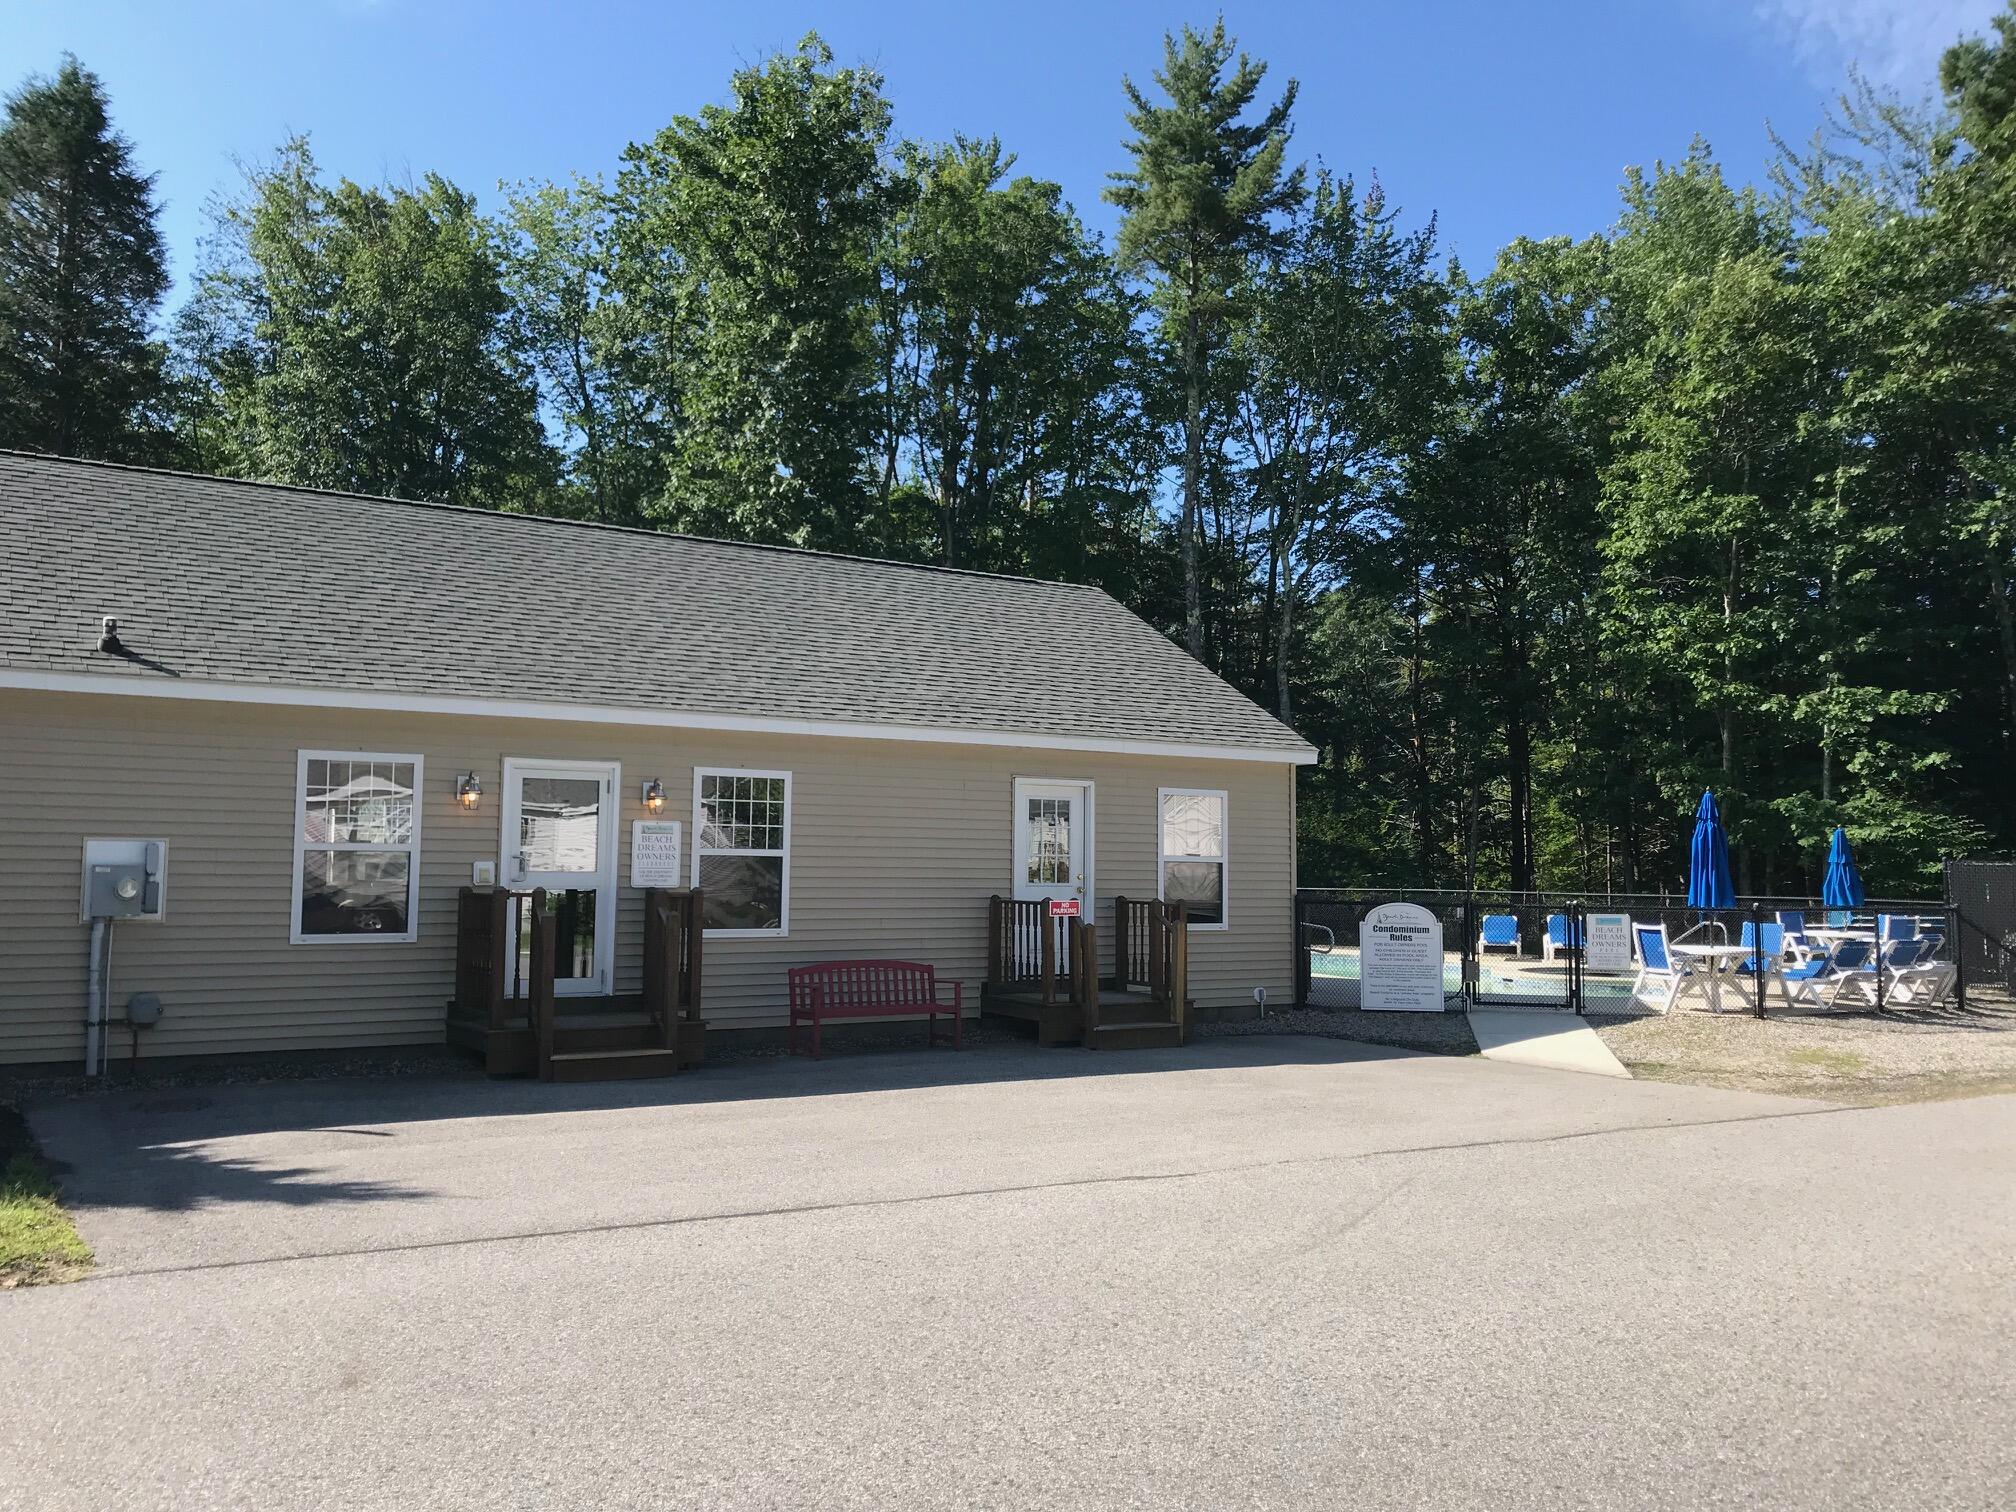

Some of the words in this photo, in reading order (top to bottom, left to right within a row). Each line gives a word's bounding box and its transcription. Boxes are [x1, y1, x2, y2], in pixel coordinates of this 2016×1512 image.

[641, 835, 673, 843] BEACH
[1372, 924, 1430, 934] Condominium
[1389, 933, 1413, 942] Rules
